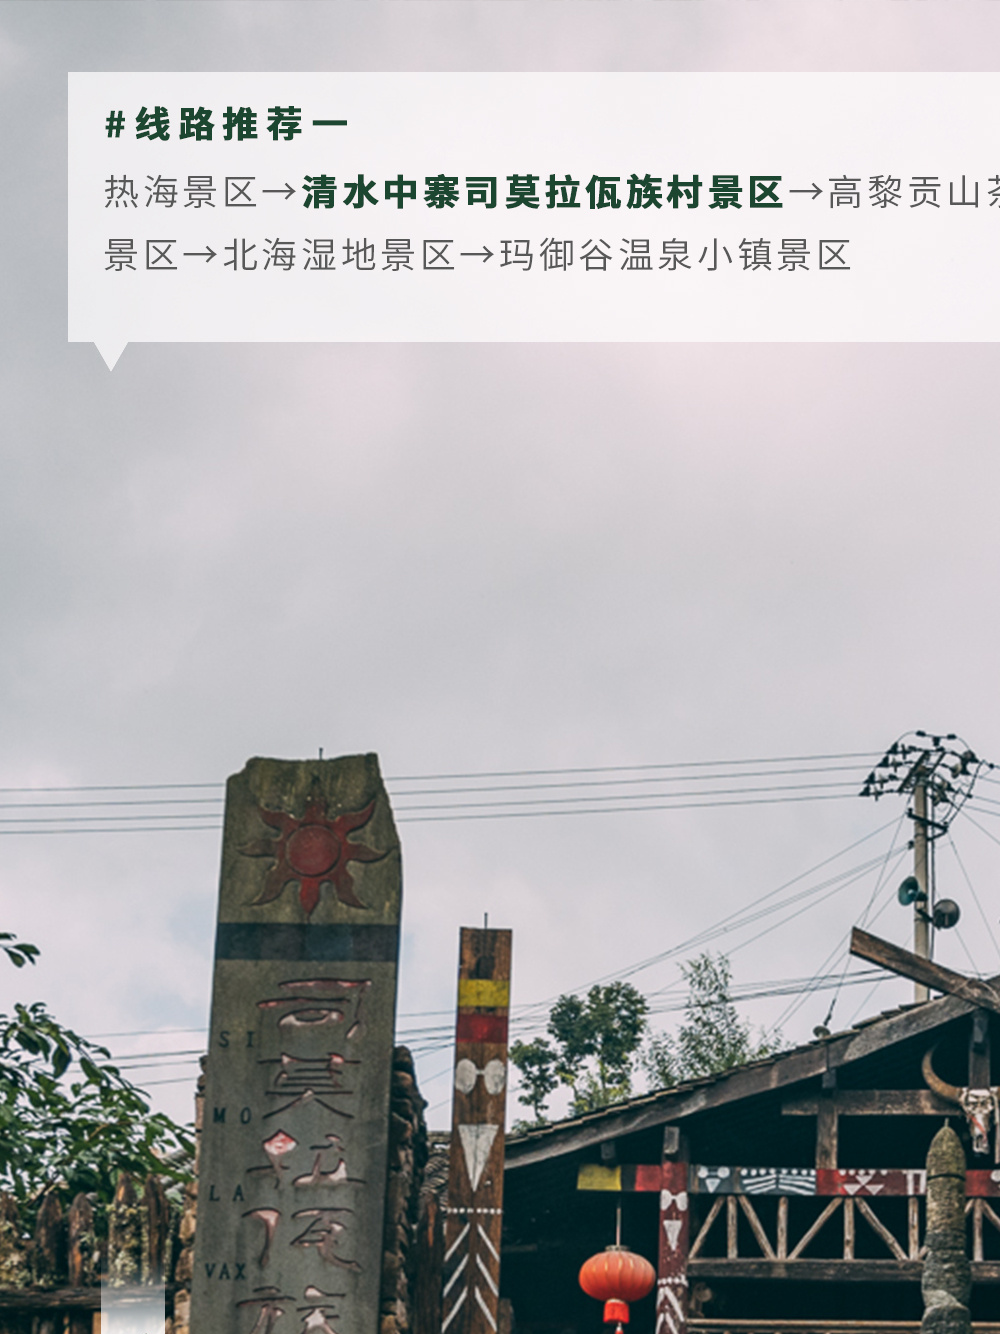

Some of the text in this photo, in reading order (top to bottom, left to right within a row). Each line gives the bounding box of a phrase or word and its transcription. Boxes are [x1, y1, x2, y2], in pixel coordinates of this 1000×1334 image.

[218, 1030, 256, 1048] SI
[213, 1106, 252, 1125] MO
[208, 1184, 245, 1202] LA
[204, 1262, 247, 1280] VAX
